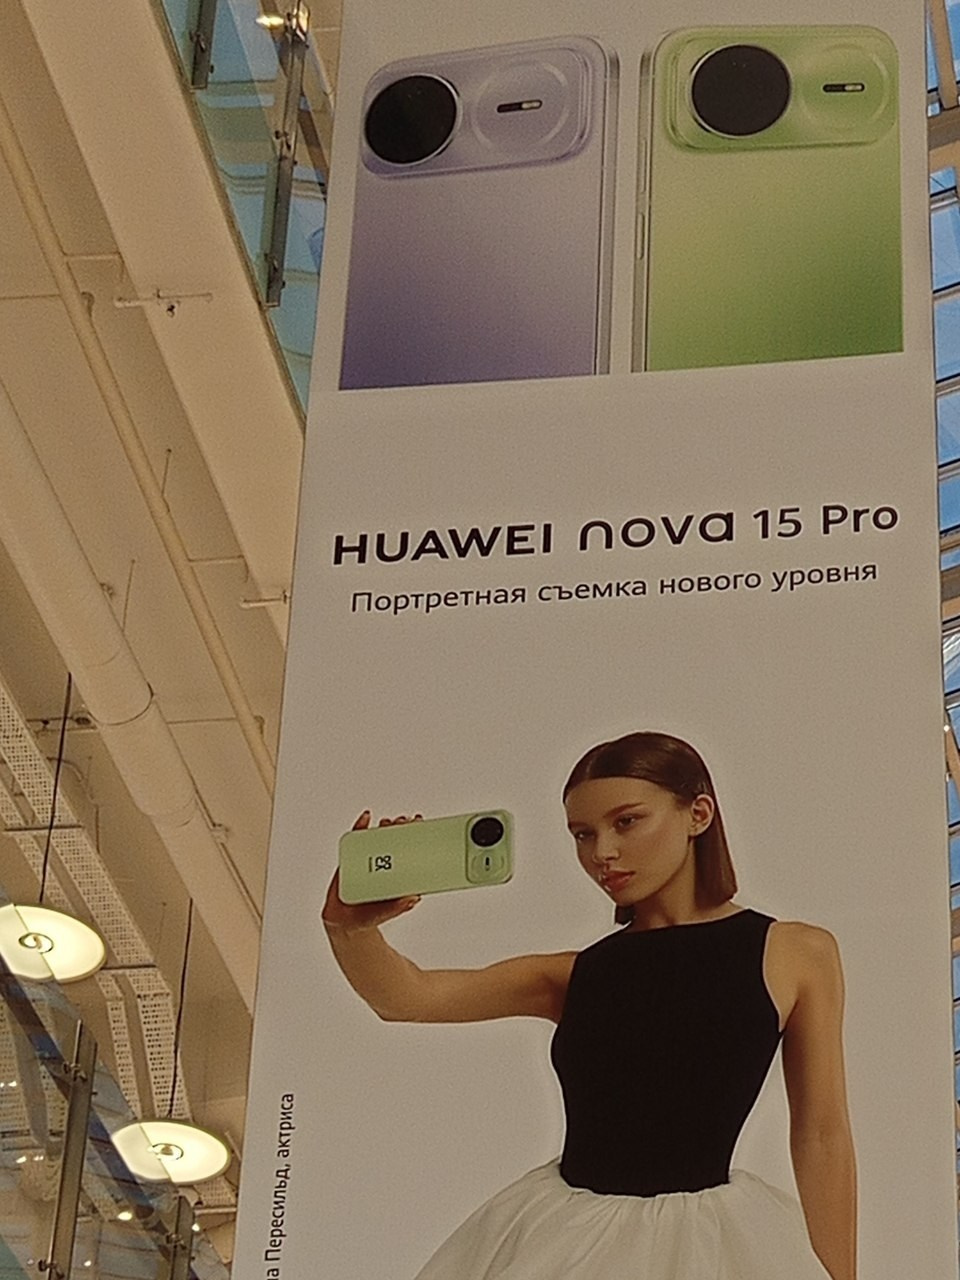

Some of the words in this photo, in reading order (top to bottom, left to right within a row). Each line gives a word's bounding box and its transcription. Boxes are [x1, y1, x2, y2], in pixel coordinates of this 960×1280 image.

[333, 523, 552, 564] HUAWEI
[579, 512, 735, 550] nova
[754, 508, 801, 538] 15
[822, 505, 899, 534] Pro
[352, 585, 526, 614] Портретная
[538, 578, 647, 602] съемка
[659, 571, 762, 595] нового
[771, 564, 877, 592] уровня
[277, 1093, 296, 1158] актриса
[264, 1163, 291, 1262] Пересильд,
